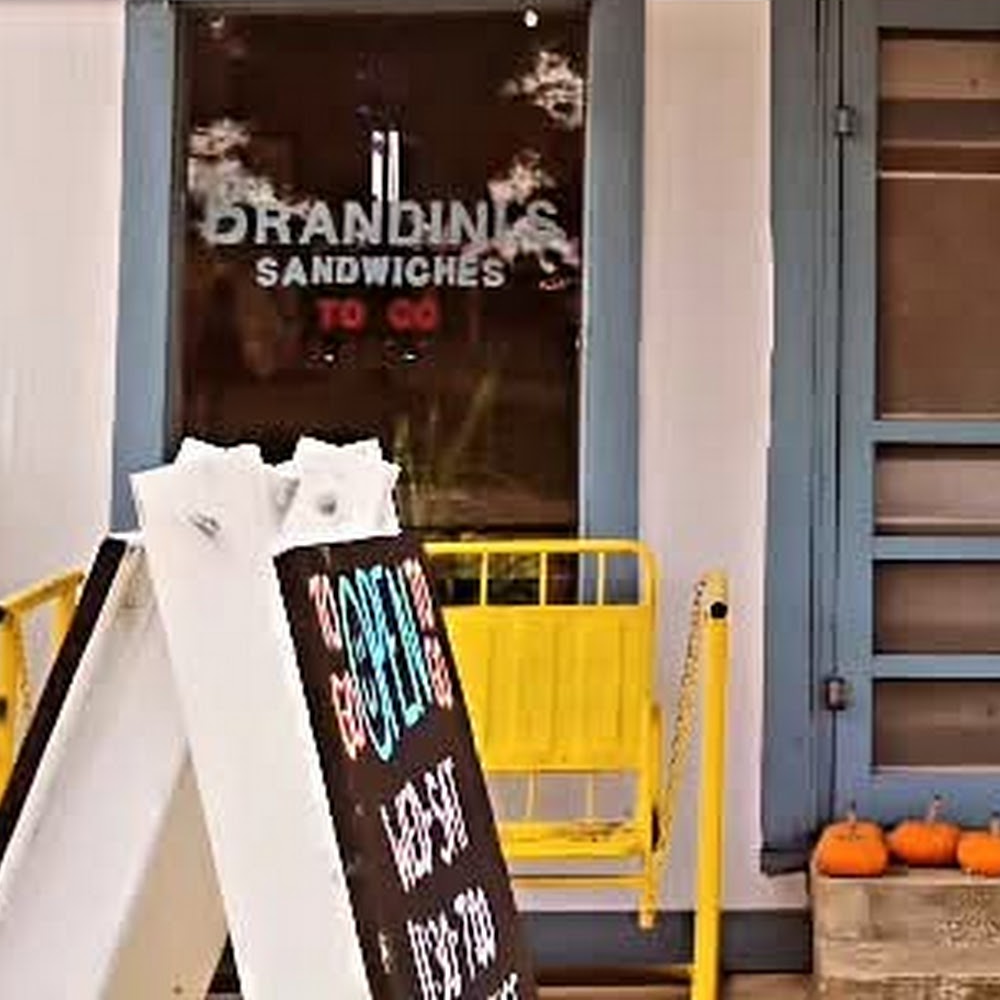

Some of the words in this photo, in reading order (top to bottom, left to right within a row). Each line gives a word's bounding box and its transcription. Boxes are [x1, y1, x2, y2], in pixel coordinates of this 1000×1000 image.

[255, 255, 506, 288] SANDWICHES
[317, 299, 364, 330] TO
[338, 564, 434, 761] OPEN
